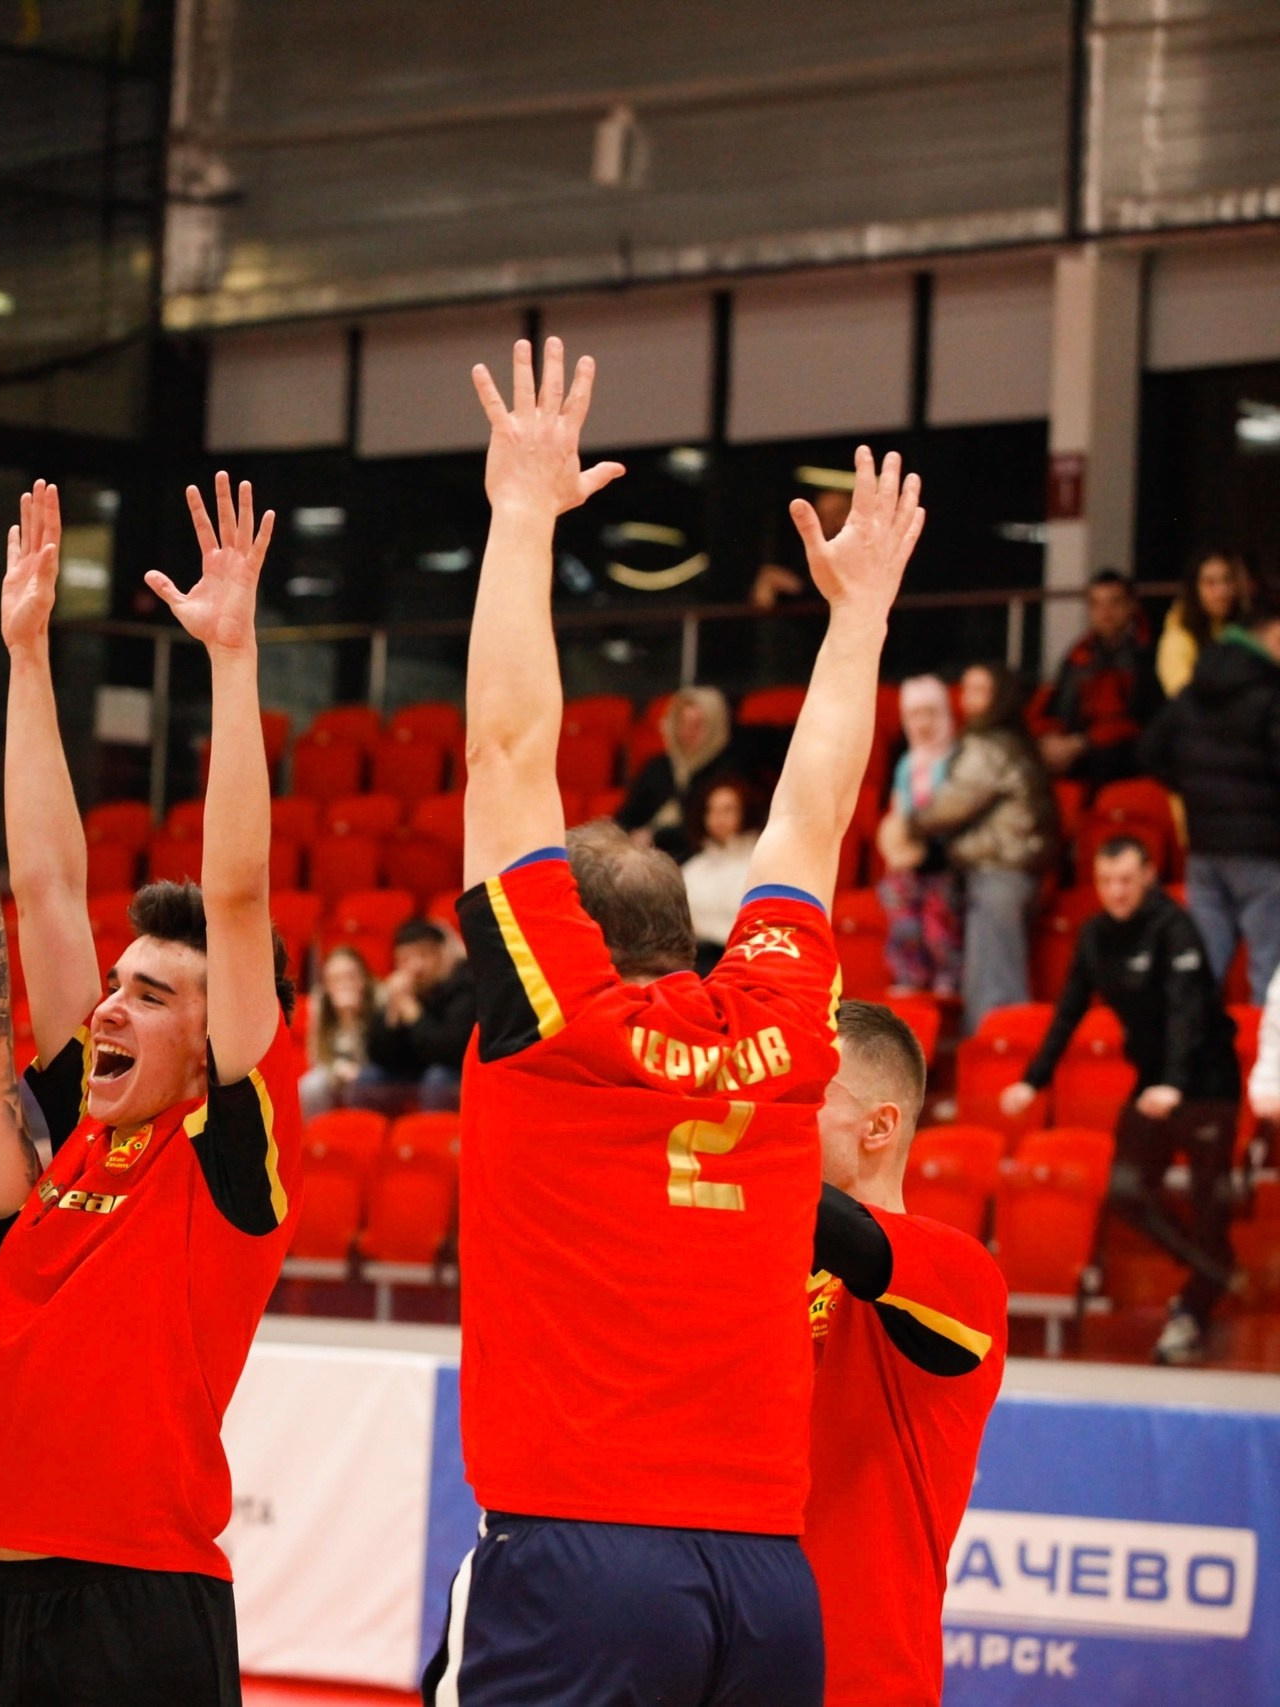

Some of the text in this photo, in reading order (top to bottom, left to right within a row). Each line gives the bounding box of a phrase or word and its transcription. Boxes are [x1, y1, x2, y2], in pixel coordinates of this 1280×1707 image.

[667, 1100, 755, 1211] 2
[953, 1539, 1236, 1609] АЧЕВО
[943, 1630, 1078, 1678] ИРСК
